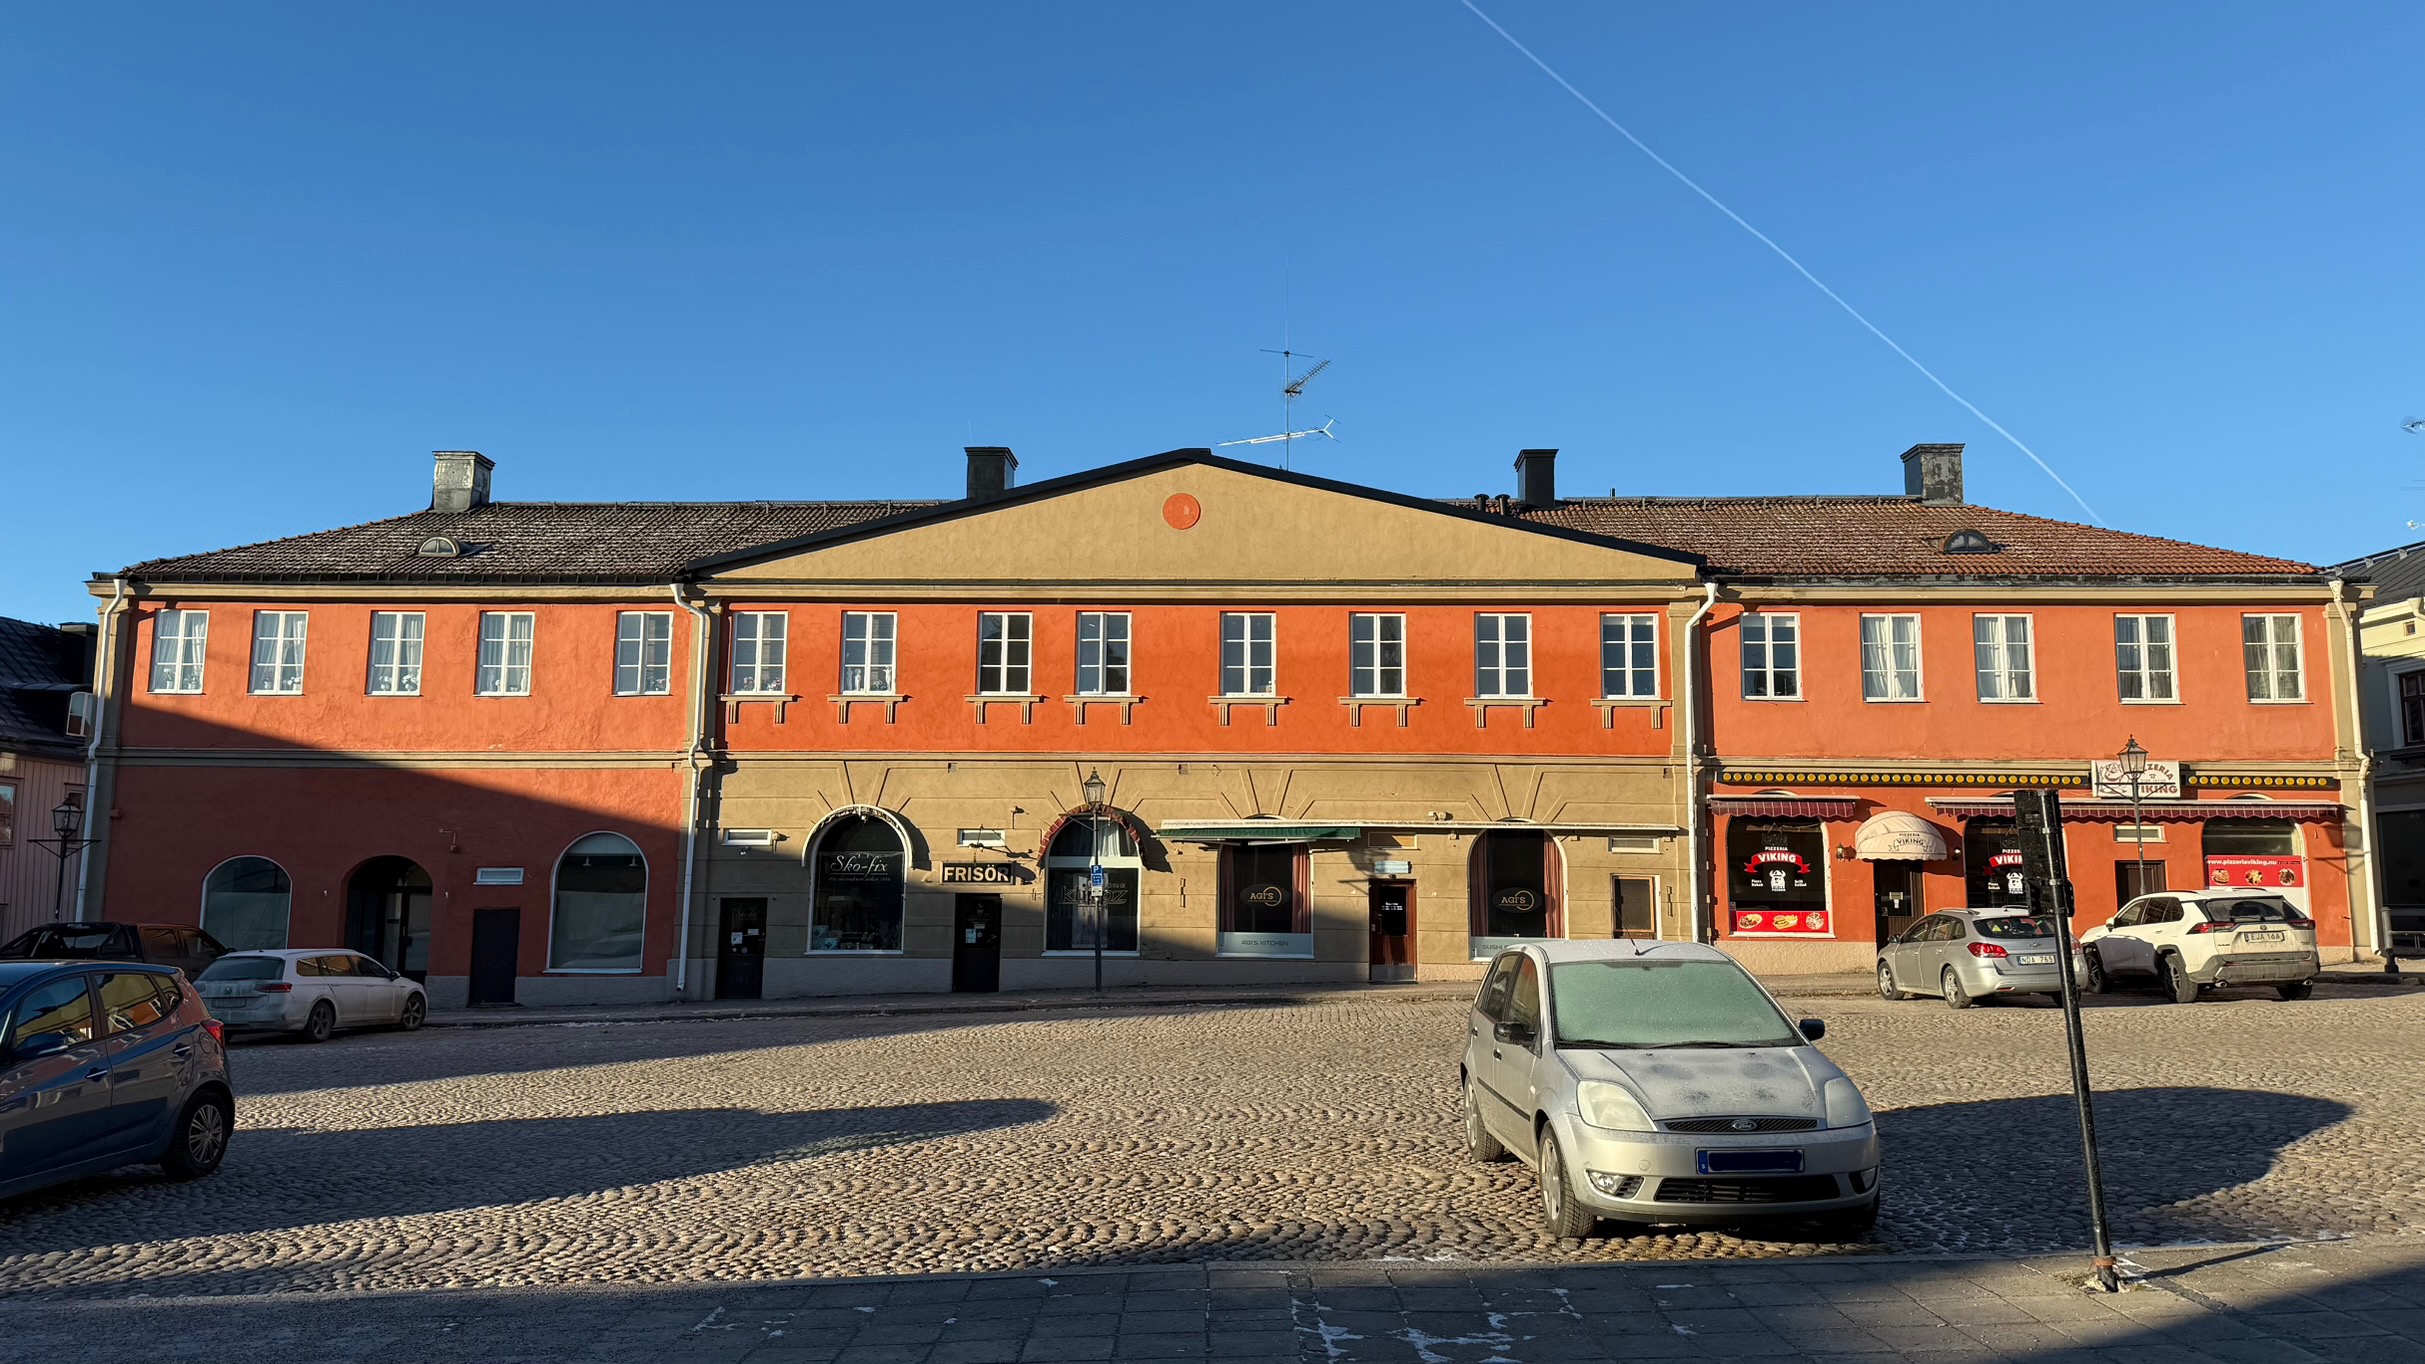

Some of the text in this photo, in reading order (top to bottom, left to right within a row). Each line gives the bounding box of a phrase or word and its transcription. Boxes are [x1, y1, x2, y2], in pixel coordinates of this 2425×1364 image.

[2146, 763, 2174, 780] ZERIA
[2140, 785, 2178, 793] IKING
[1758, 852, 1796, 862] VIKING
[1994, 855, 2023, 864] VIKI
[830, 855, 888, 878] Sko-fix
[944, 864, 1009, 882] FRISÖR
